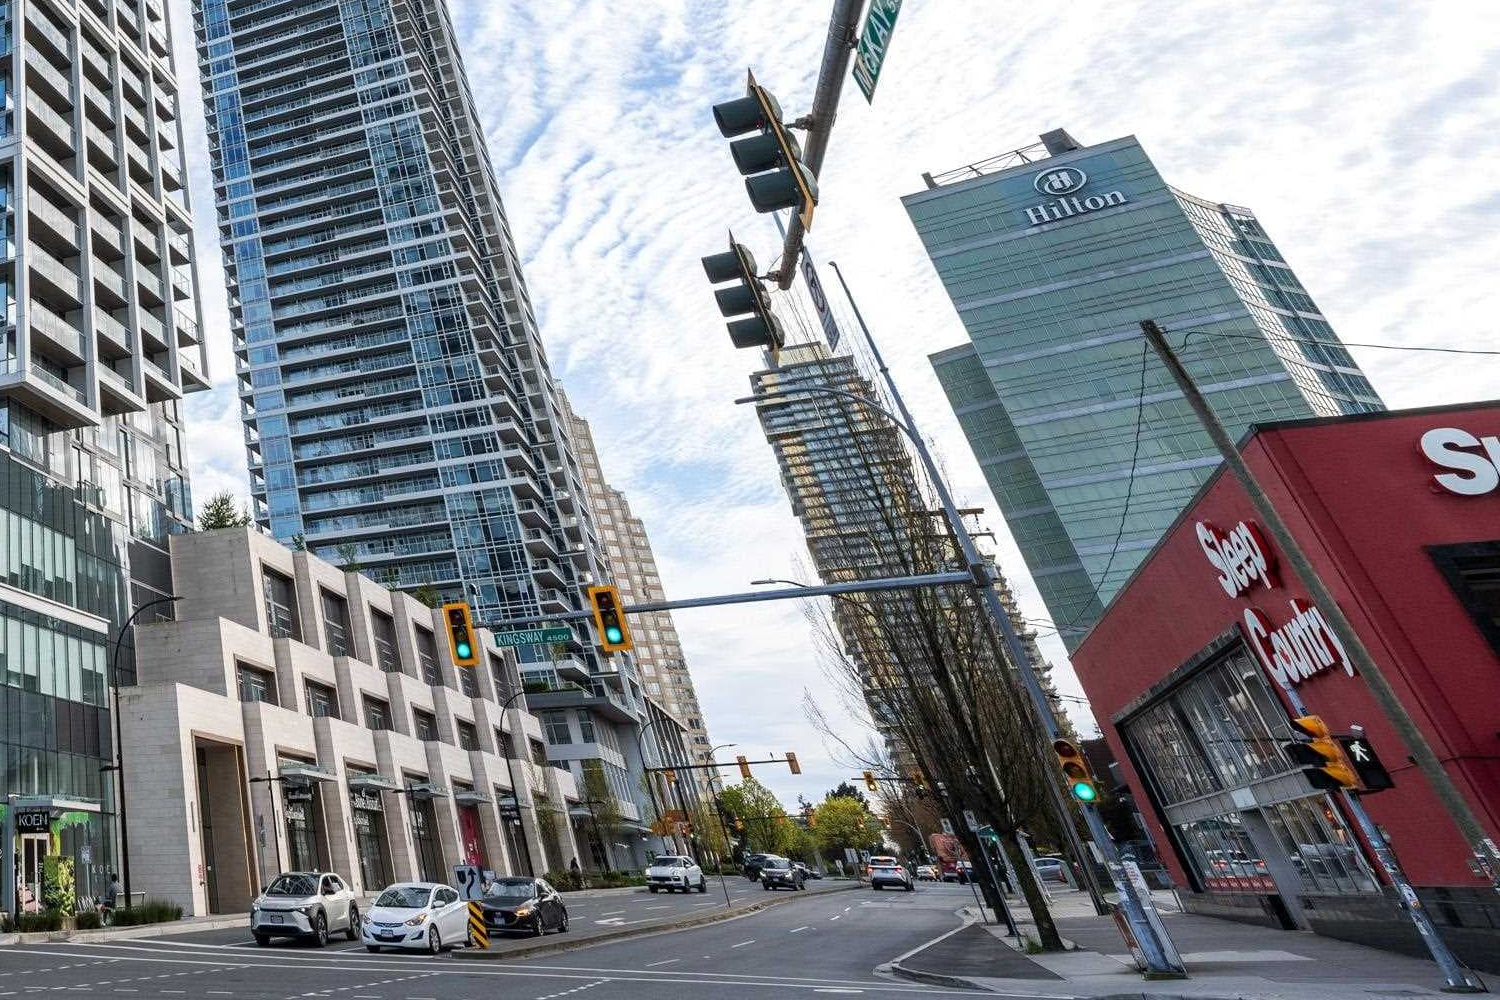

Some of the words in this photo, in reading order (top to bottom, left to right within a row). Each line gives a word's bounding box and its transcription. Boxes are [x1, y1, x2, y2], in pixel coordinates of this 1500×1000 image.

[1023, 190, 1128, 225] Hilton
[1195, 521, 1272, 599] Sleep
[496, 631, 544, 646] KINGSWAY
[547, 634, 569, 642] 4500
[1243, 599, 1354, 688] Country
[19, 813, 48, 826] KOEN
